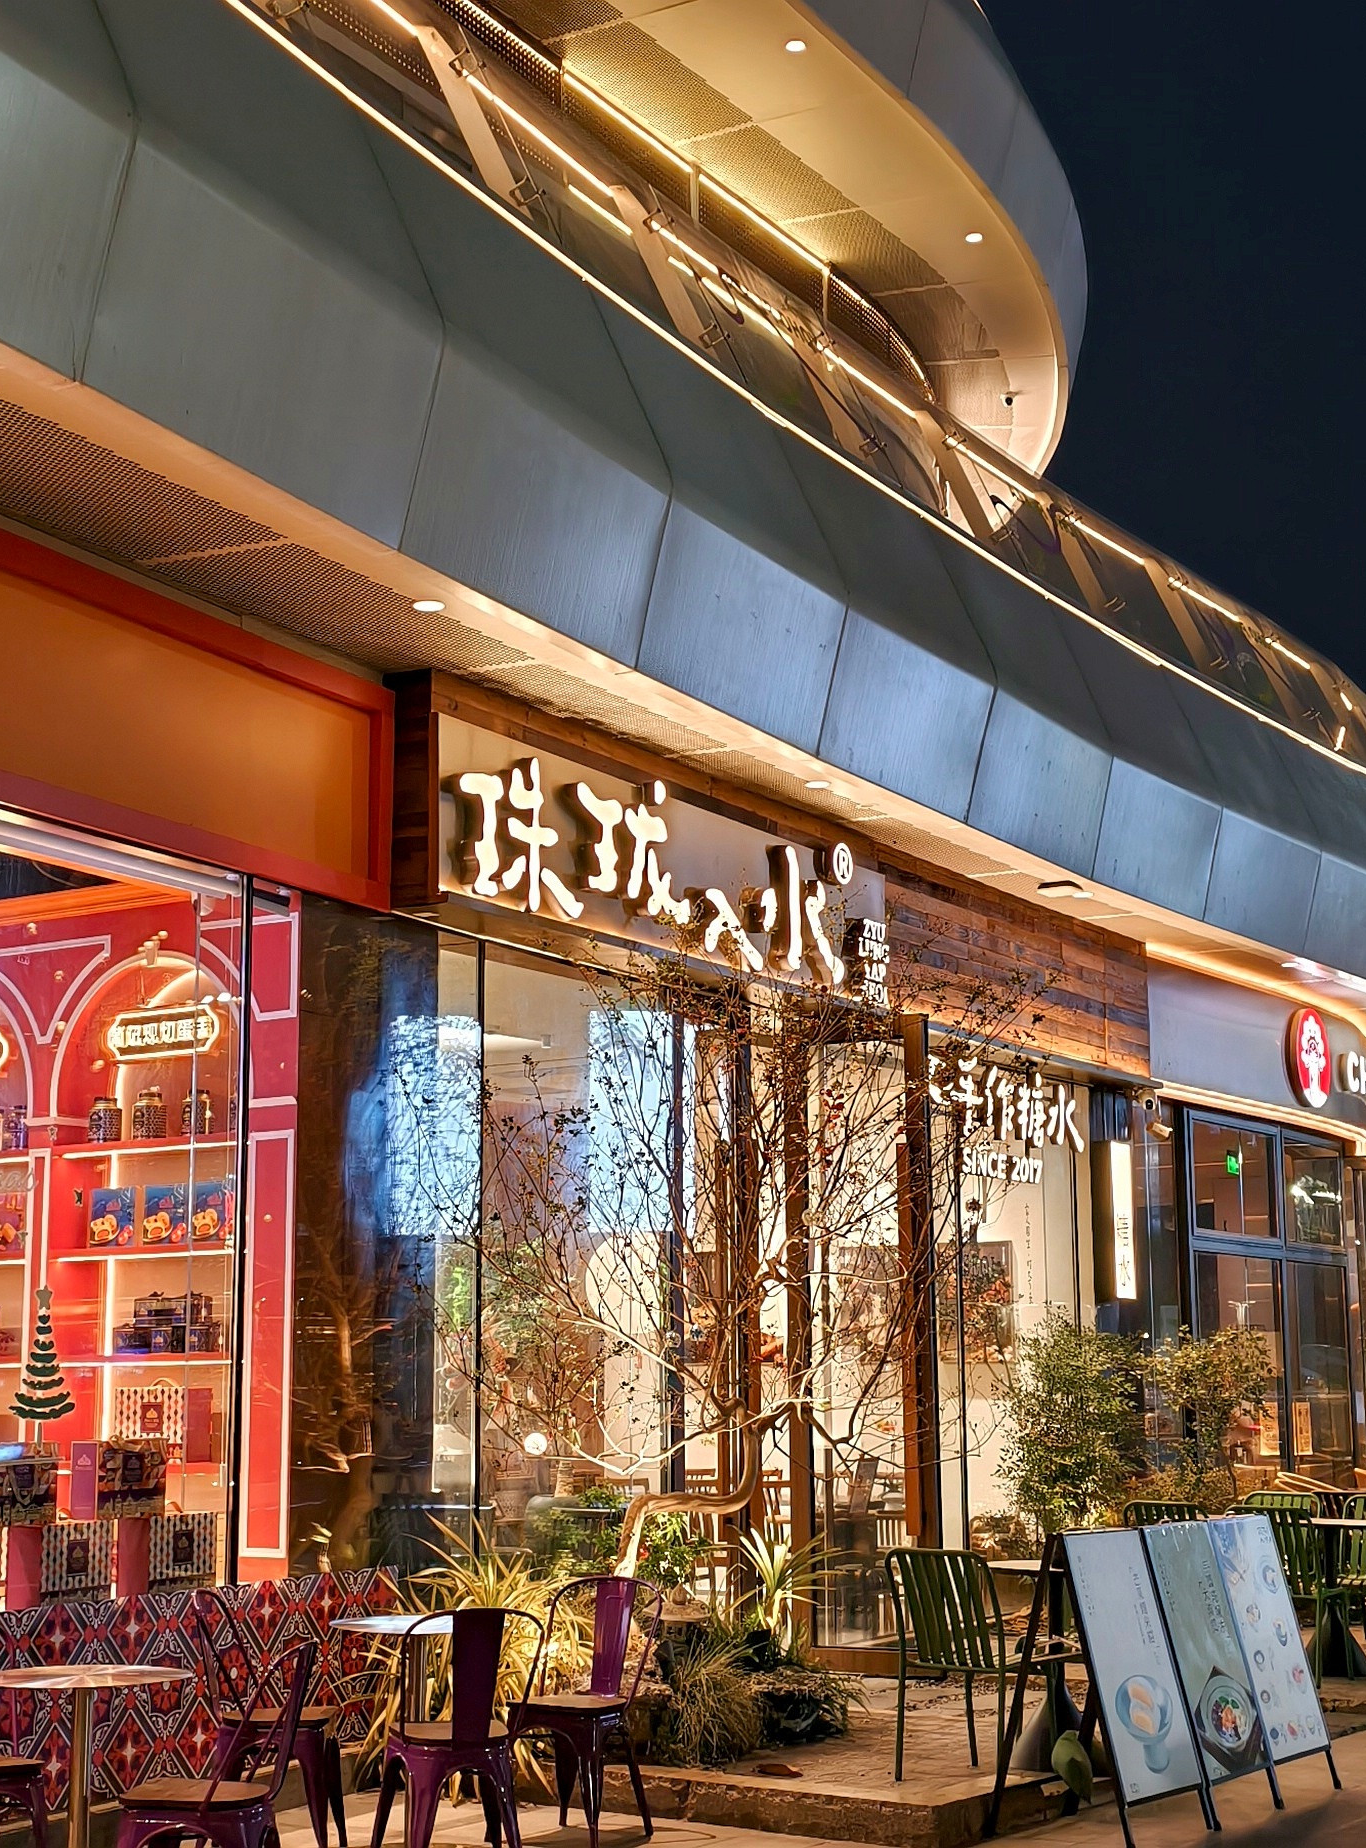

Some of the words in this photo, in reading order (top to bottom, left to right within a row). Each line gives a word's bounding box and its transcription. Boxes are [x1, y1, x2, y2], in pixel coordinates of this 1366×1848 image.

[459, 757, 845, 985] 珠珑入水
[863, 918, 887, 942] ZYU
[962, 1146, 1009, 1179] SINCE
[1011, 1155, 1044, 1185] 2017
